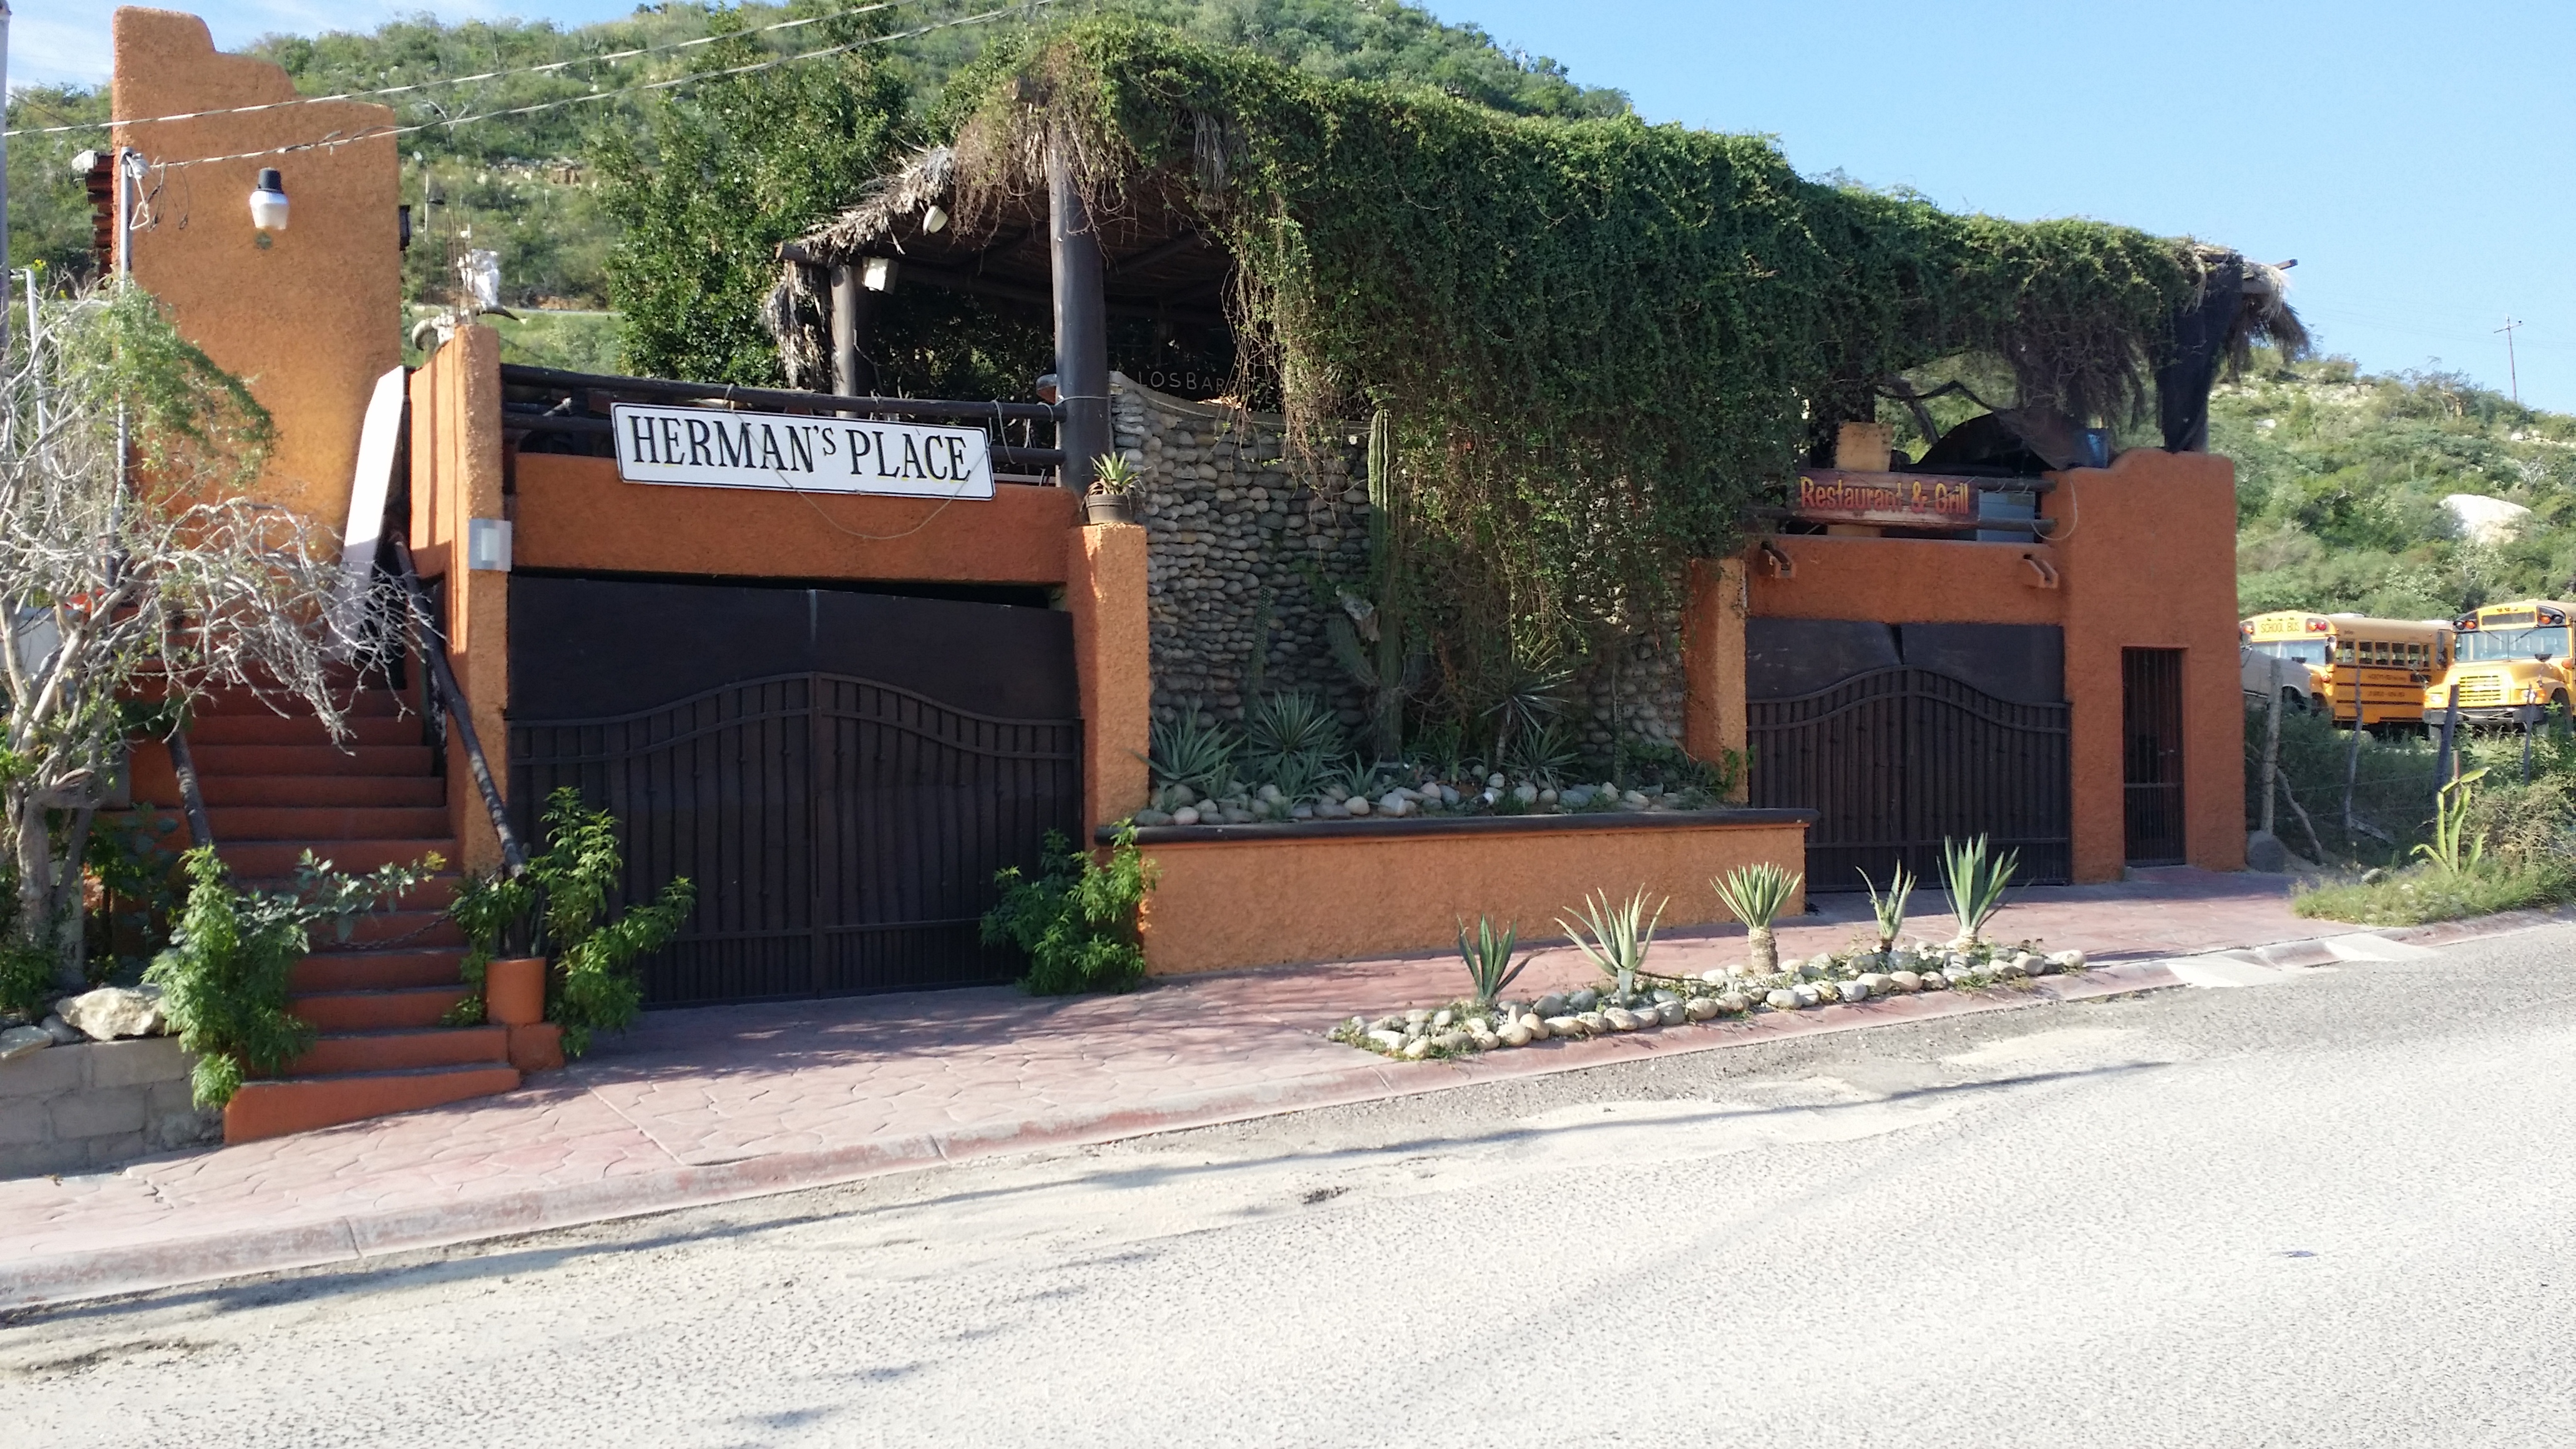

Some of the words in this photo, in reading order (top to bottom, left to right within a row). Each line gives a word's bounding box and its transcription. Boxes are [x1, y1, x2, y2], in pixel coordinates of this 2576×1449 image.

[844, 429, 971, 482] PLACE
[1800, 476, 1903, 513] Restaurant
[1911, 480, 1928, 513] &
[1935, 482, 1969, 514] Grill
[2261, 623, 2284, 633] SCHOOL
[2287, 622, 2300, 632] BUS
